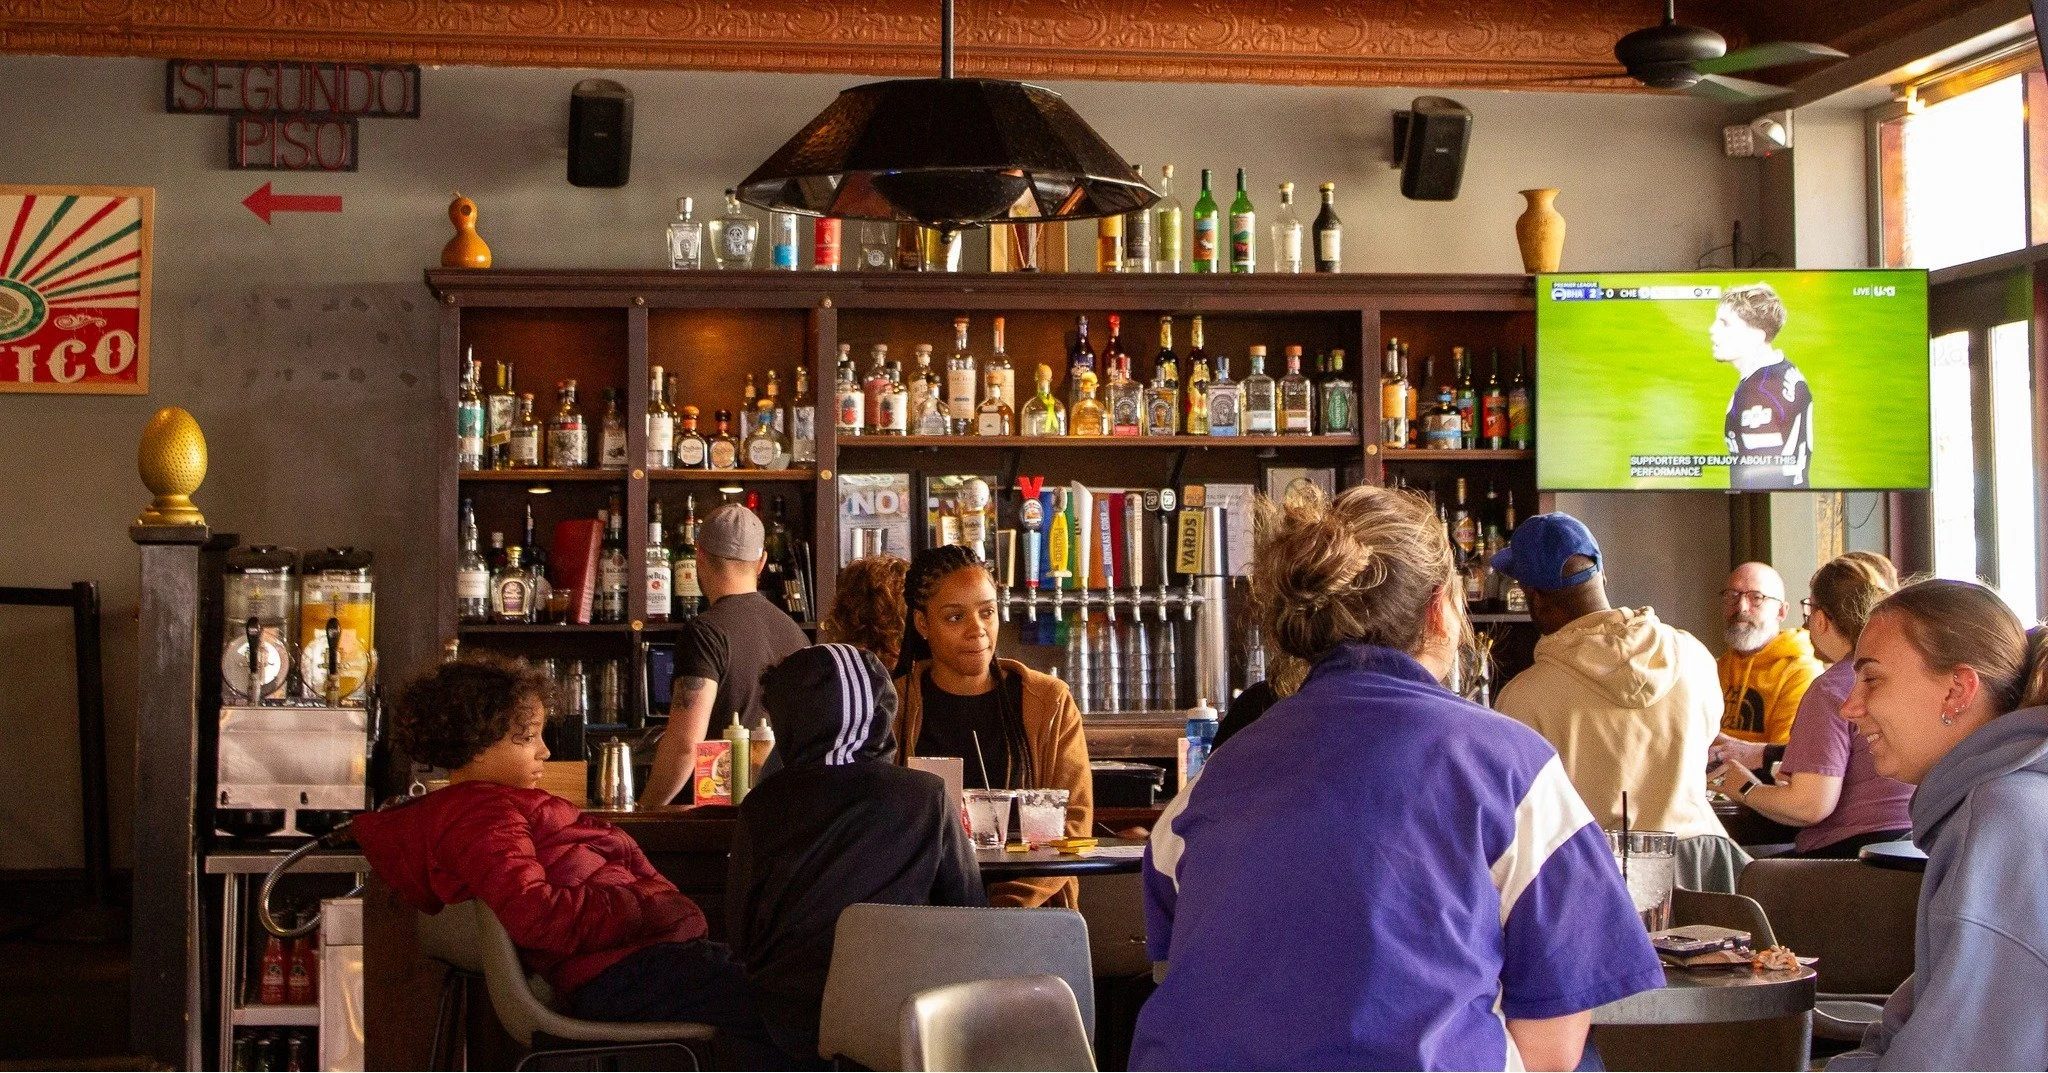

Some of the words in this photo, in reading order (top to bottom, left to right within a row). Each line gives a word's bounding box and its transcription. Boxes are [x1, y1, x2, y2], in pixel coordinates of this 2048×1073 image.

[178, 62, 408, 117] SEGUNDO
[240, 116, 347, 171] PISO
[1620, 288, 1637, 298] CHE
[0, 329, 136, 384] ICO
[1631, 456, 1691, 466] SUPPORTERS
[1693, 456, 1706, 466] TO
[1707, 456, 1737, 466] ENJOY
[1740, 456, 1773, 466] ABOUT
[1774, 456, 1797, 466] THIS
[1631, 467, 1702, 477] PERFORMANCE.
[1183, 517, 1197, 566] YARDS
